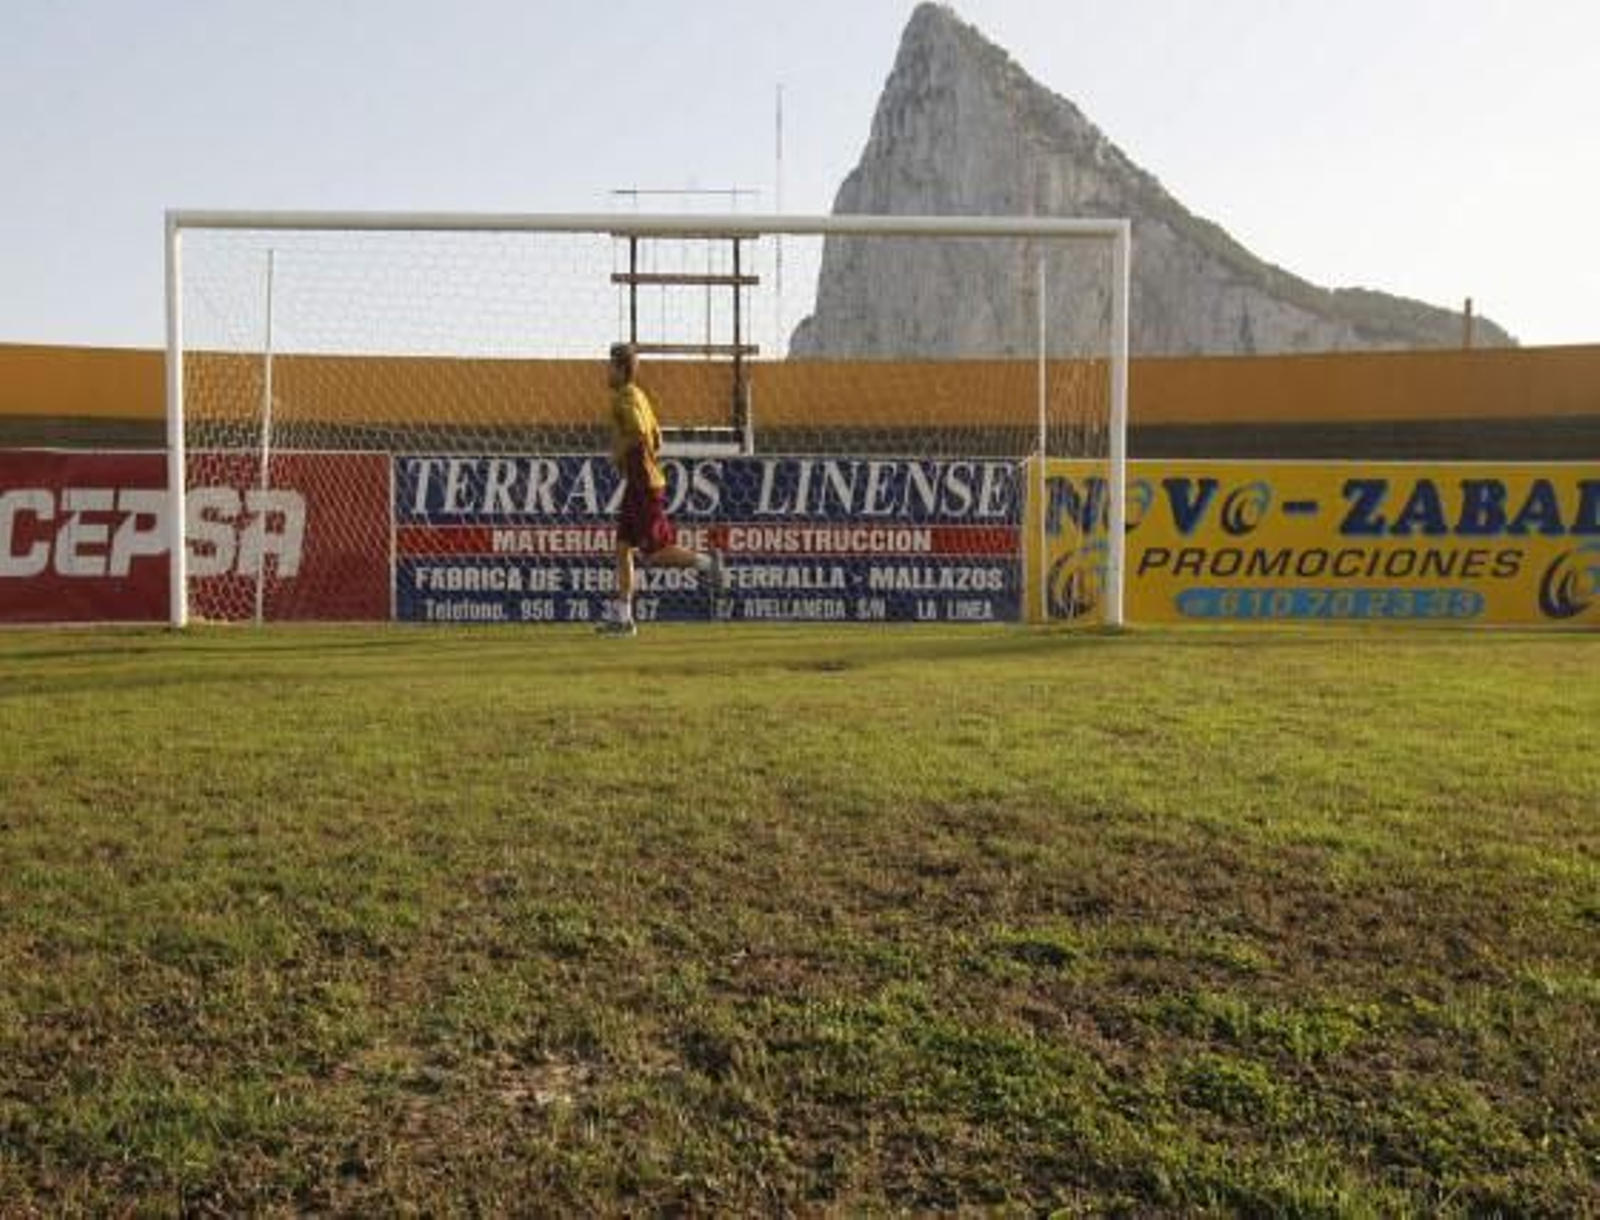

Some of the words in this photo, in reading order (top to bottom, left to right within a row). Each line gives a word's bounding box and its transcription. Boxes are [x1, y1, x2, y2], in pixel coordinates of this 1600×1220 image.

[753, 459, 1013, 517] LINENSE
[0, 488, 306, 577] CEPSA
[677, 529, 709, 551] DE
[727, 528, 932, 551] CONSTRUCCION
[1138, 547, 1524, 577] PROMOCIONES
[415, 566, 522, 591] FABRICA
[529, 567, 567, 591] DE
[570, 566, 700, 591] TERAZOS
[722, 565, 846, 590] FERRALLA
[869, 566, 1004, 591] MALLAZOS
